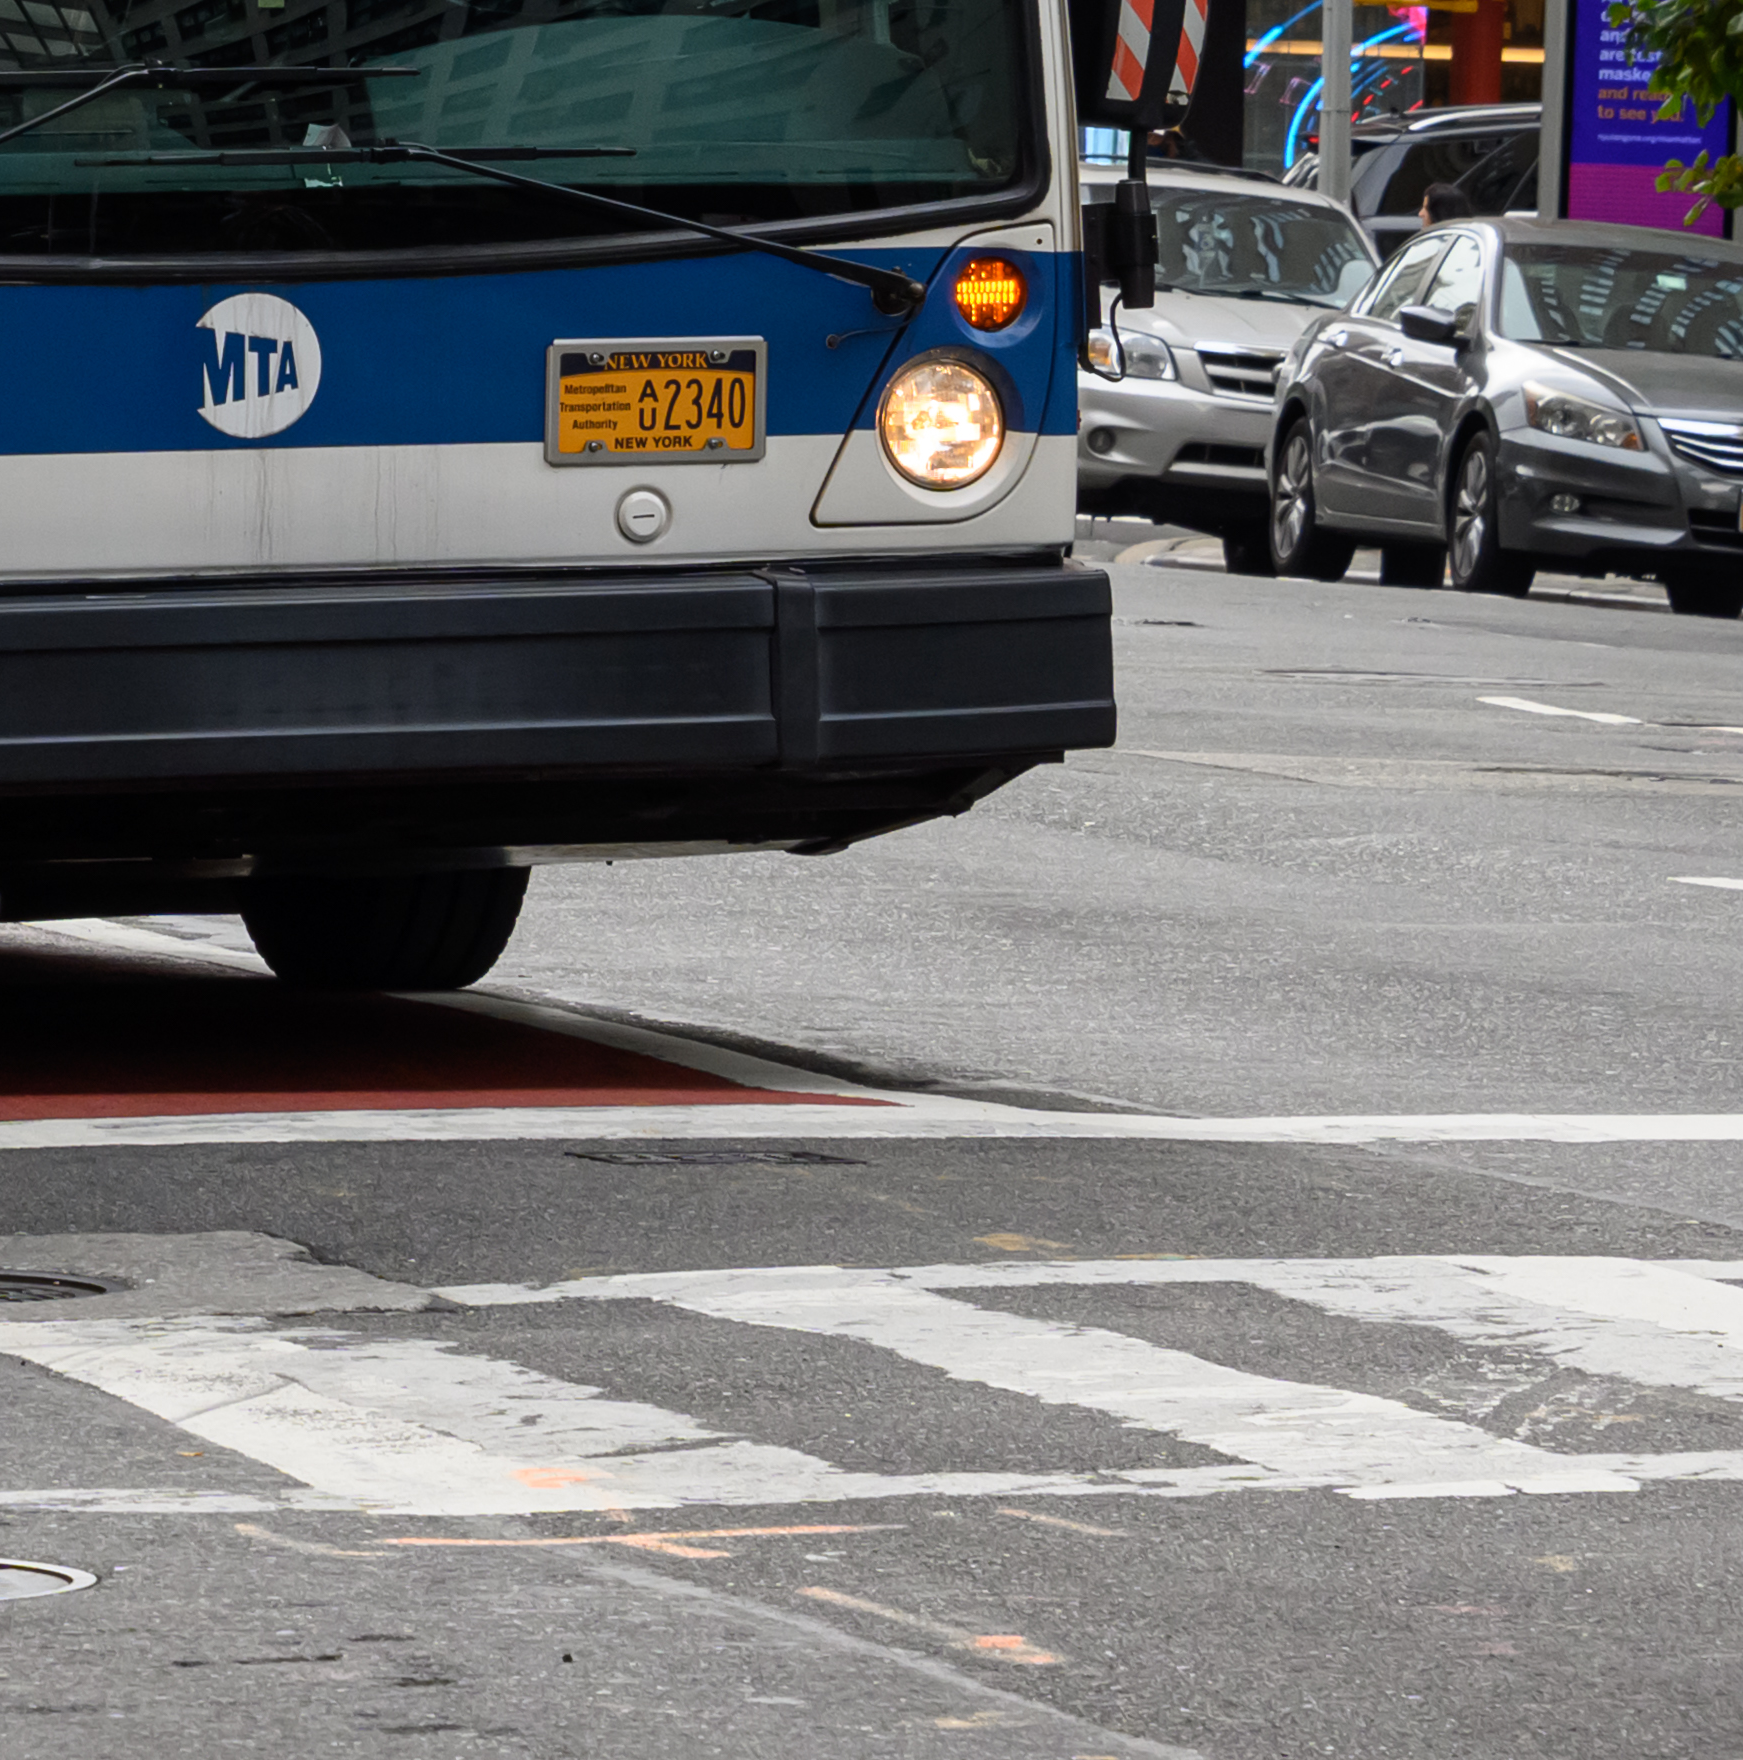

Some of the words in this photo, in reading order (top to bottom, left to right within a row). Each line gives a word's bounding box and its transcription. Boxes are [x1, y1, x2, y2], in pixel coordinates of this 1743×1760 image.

[1597, 105, 1614, 119] to
[1619, 108, 1647, 120] see
[604, 353, 652, 371] NEW
[657, 352, 708, 369] YORK
[564, 384, 627, 395] Metropolitan
[560, 402, 631, 413] Transportation
[664, 378, 746, 431] 2340
[572, 419, 618, 430] Authority
[614, 437, 650, 449] NEW
[653, 435, 693, 448] YORK
